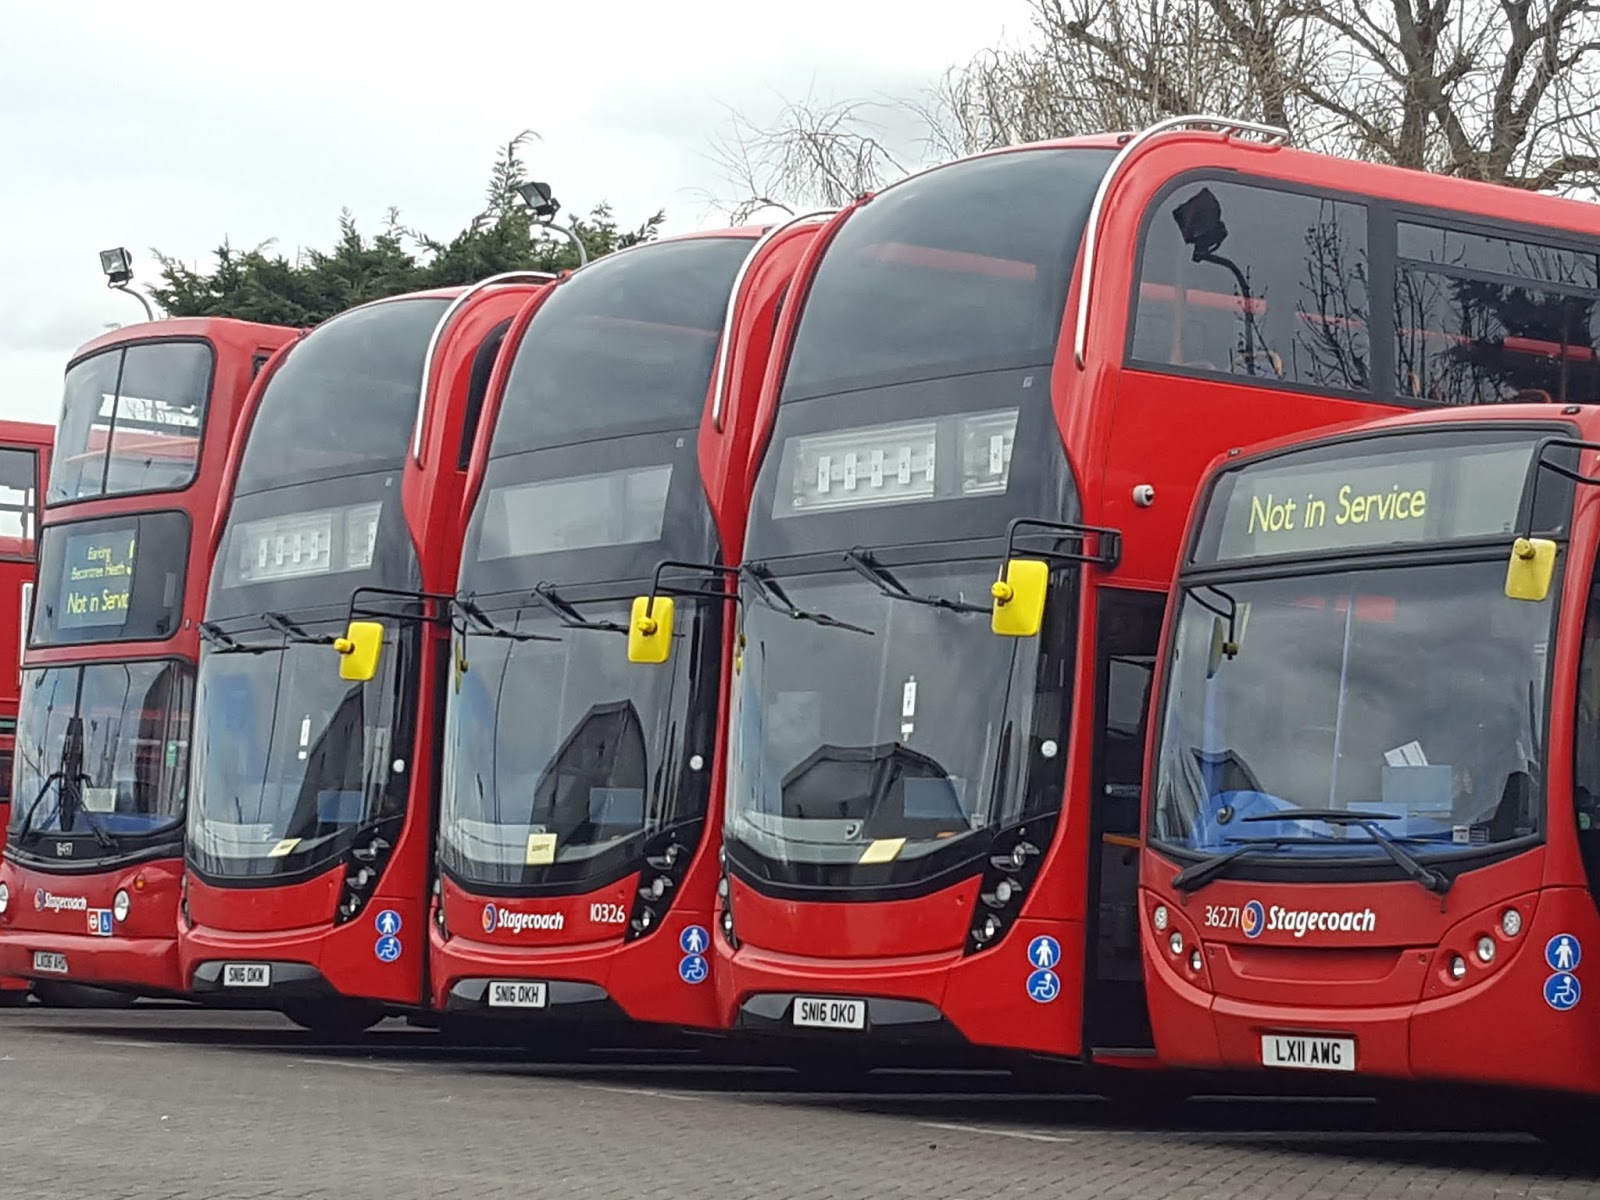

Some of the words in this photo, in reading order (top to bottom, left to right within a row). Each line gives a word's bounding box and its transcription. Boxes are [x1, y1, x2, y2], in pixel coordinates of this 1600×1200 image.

[1248, 494, 1296, 534] Not
[1303, 492, 1325, 528] in
[1335, 483, 1427, 525] Service
[67, 591, 88, 614] Not
[89, 592, 100, 612] in
[101, 588, 130, 611] Servic
[44, 891, 88, 914] Stagecoach
[589, 902, 626, 924] 10326
[496, 907, 565, 934] Stagecoach
[1204, 905, 1240, 929] 36271
[1266, 904, 1376, 938] Stagecoach
[494, 984, 517, 1003] SN16
[517, 984, 540, 1004] OKH
[800, 1001, 828, 1023] SN16
[1275, 1038, 1307, 1063] LX11
[1309, 1040, 1342, 1065] AWG
